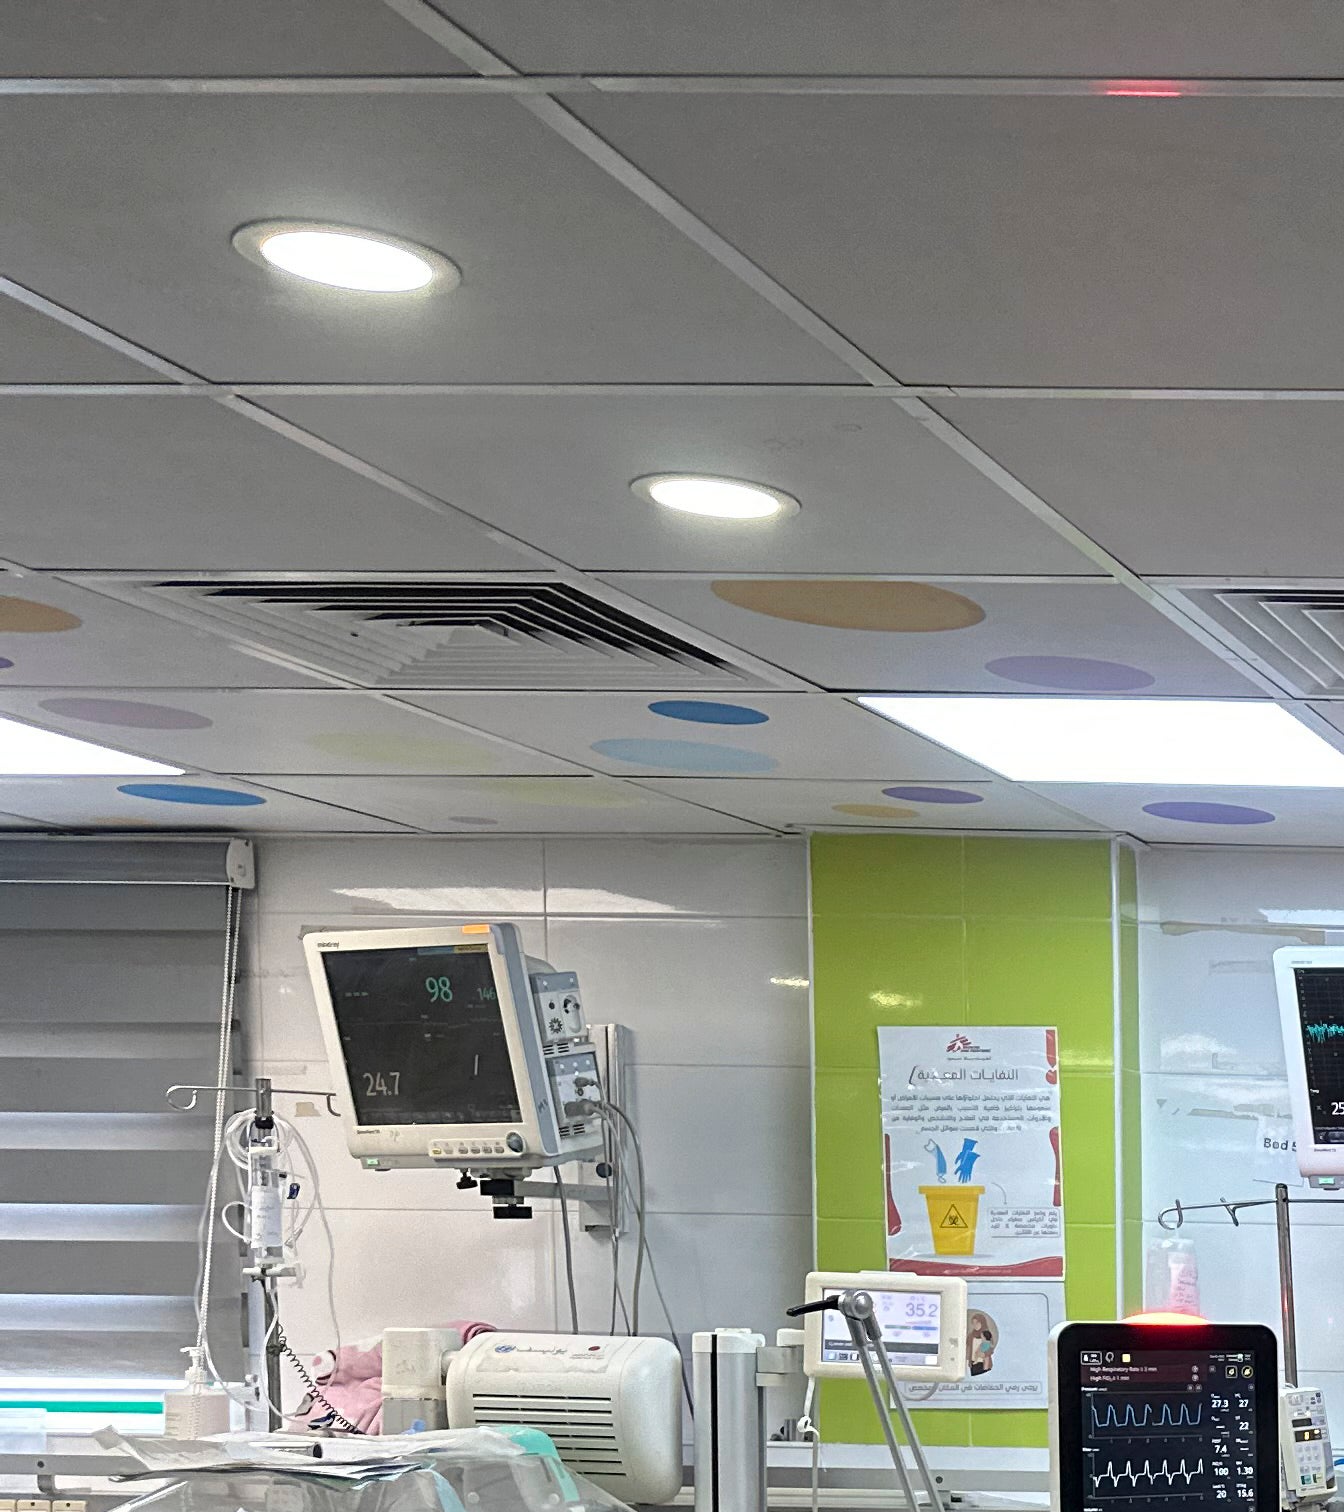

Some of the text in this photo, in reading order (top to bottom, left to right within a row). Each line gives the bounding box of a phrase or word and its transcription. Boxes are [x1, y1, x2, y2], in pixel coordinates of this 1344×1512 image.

[425, 977, 452, 1002] 98
[970, 1069, 1018, 1083] النفايات
[363, 1072, 400, 1096] 24.7
[1264, 1138, 1288, 1150] Bed
[906, 1303, 938, 1317] 35.2
[1211, 1400, 1228, 1408] 27.3
[1239, 1399, 1248, 1408] 27
[1239, 1422, 1249, 1430] 22
[1214, 1445, 1227, 1453] 7.4
[1237, 1467, 1253, 1475] 1.30
[1237, 1489, 1254, 1498] 15.6
